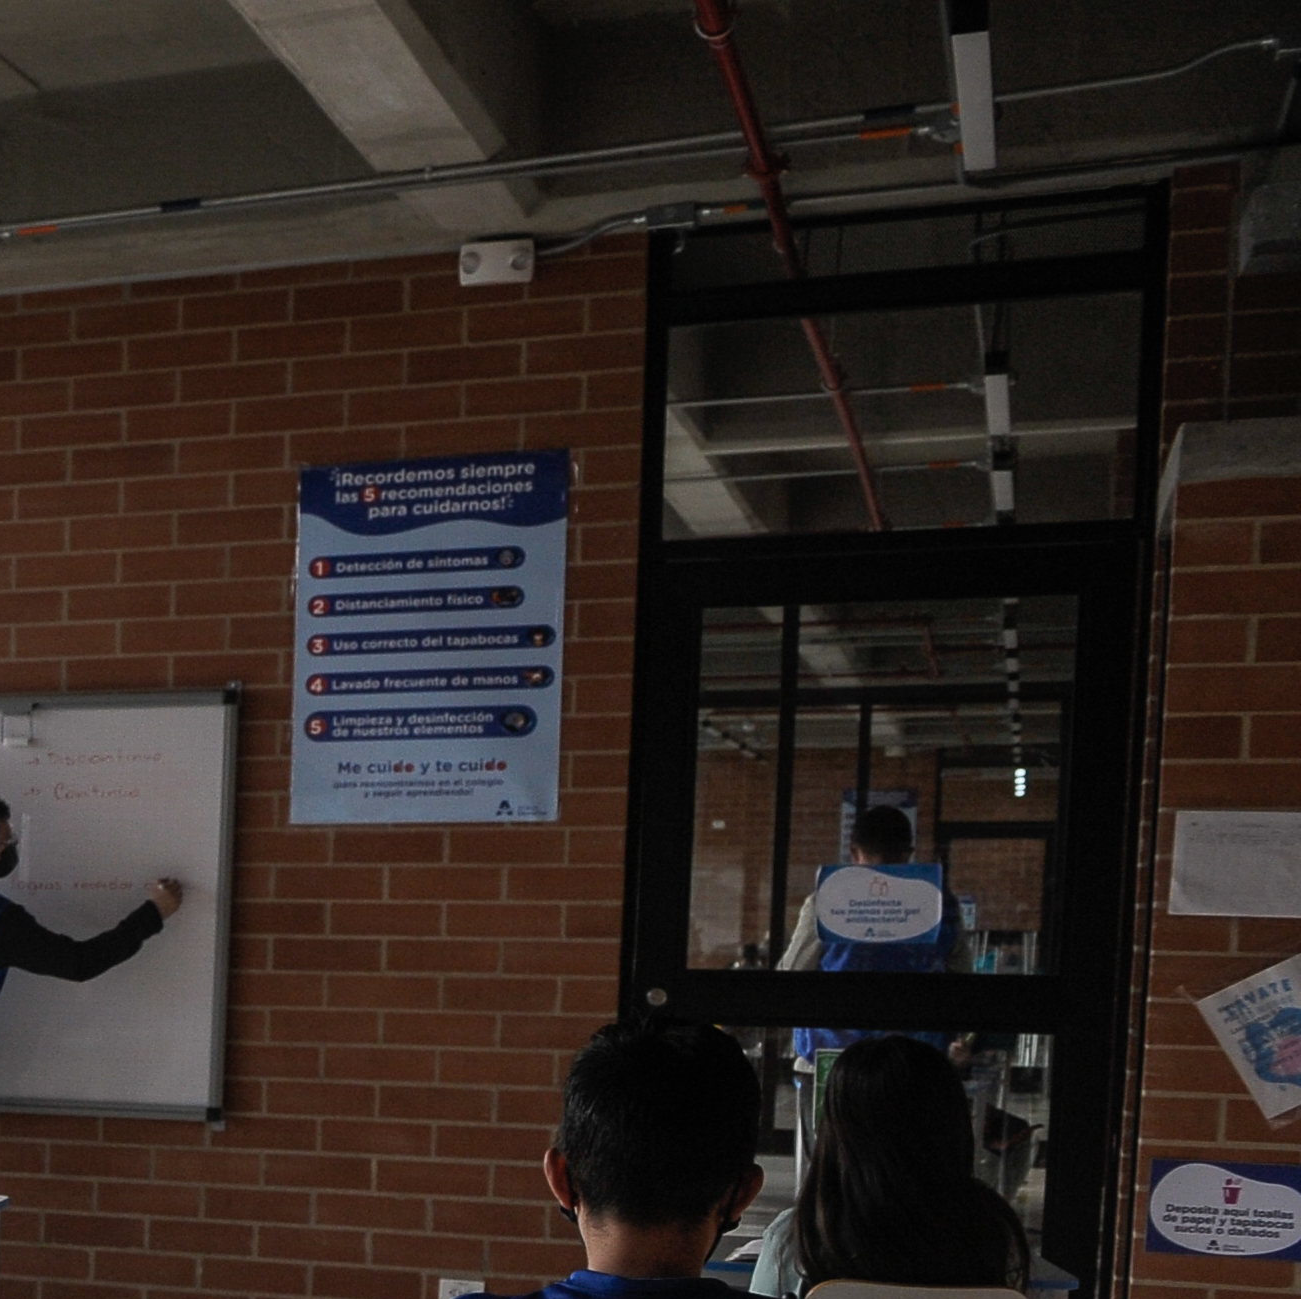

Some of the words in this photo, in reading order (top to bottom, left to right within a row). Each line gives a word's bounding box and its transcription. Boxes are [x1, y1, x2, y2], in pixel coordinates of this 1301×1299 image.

[335, 468, 456, 487] ¡Recordemos
[460, 463, 536, 479] siempre
[335, 490, 358, 504] las
[362, 487, 376, 502] 5
[380, 481, 534, 500] recomendaciones
[368, 504, 408, 520] para
[412, 496, 506, 515] cuidarnos!
[314, 561, 325, 576] 1
[335, 558, 403, 573] Detección
[406, 557, 424, 569] de
[427, 554, 489, 568] síntomas
[312, 599, 325, 614] 2
[334, 594, 443, 611] Distanciamiento
[447, 592, 484, 606] físico
[311, 638, 324, 654] 3
[333, 640, 358, 651] Uso
[360, 637, 417, 650] correcto
[421, 635, 443, 647] del
[447, 632, 519, 648] tapabocas
[309, 677, 323, 692] 4
[331, 678, 381, 691] Lavado
[383, 676, 447, 689] frecuente
[451, 675, 469, 687] de
[473, 673, 519, 686] manos
[310, 719, 322, 735] 5
[333, 715, 393, 729] Limpieza
[396, 717, 405, 728] y
[407, 710, 494, 725] desinfección
[332, 726, 349, 738] de
[352, 725, 410, 736] nuestros
[413, 723, 484, 735] elementos
[337, 761, 362, 775] Me
[366, 759, 415, 774] cuido
[420, 762, 431, 775] y
[435, 759, 453, 772] te
[457, 757, 508, 773] cuido
[1162, 1214, 1179, 1223] de
[1181, 1215, 1216, 1226] papel
[1218, 1218, 1228, 1227] y
[1229, 1217, 1295, 1230] tapabocas
[1165, 1203, 1220, 1216] Deposita
[1252, 1208, 1294, 1220] toallas
[1174, 1225, 1212, 1235] sucios
[1215, 1227, 1225, 1235] o
[1227, 1226, 1281, 1239] dañados
